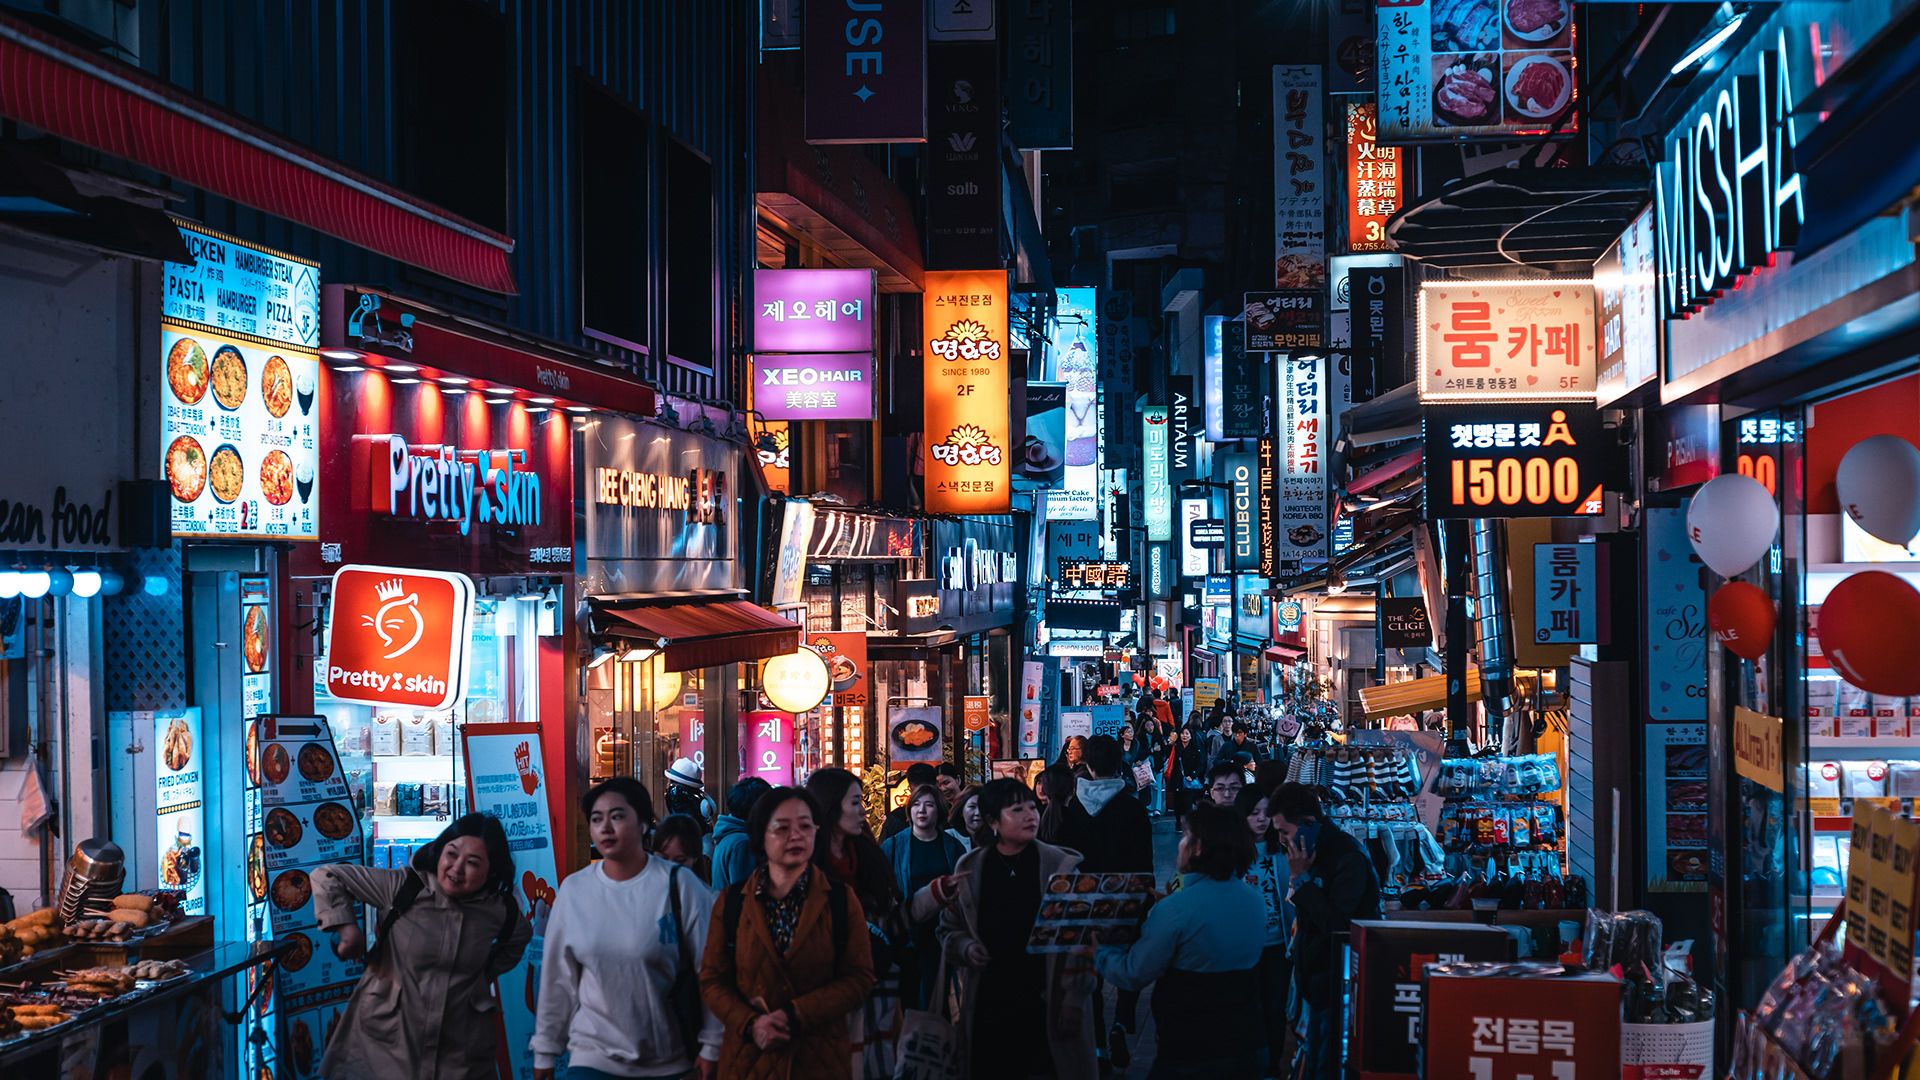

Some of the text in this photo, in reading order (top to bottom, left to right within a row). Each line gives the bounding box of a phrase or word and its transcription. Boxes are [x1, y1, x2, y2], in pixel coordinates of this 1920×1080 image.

[1393, 11, 1414, 127] 한우삼겹
[1656, 27, 1805, 320] MISSHA
[947, 182, 979, 196] solb
[235, 250, 294, 285] HAMBURGER STEAK
[169, 276, 205, 304] PASTA
[217, 288, 257, 316] HAMBURGER
[935, 294, 993, 307] 스낵전문점
[267, 301, 293, 325] PIZZA
[762, 299, 862, 322] 제오헤어
[1266, 297, 1312, 312] 엉터리
[1274, 334, 1321, 348] 무한리필
[1443, 302, 1580, 368] 룸 카페
[930, 337, 1000, 361] 명화당
[942, 368, 991, 377] SINCE 1980
[1446, 377, 1518, 390] 스위트룸 명동점
[1559, 376, 1580, 389] 5F
[786, 391, 838, 409] 美容室
[957, 385, 975, 396] 2F
[1174, 392, 1188, 468] ARITAUM
[1451, 423, 1516, 448] 첫방문
[931, 442, 1002, 466] 명화당
[1149, 429, 1166, 514] 미도리가방
[1452, 457, 1579, 506] 15000
[389, 435, 541, 536] Pretty skin
[596, 467, 618, 504] BEE
[619, 470, 657, 509] CHENG
[658, 474, 691, 510] HIANG
[937, 480, 994, 493] 스낵전문점
[51, 486, 111, 549] food
[1236, 465, 1250, 558] CLUBCLIO
[1586, 501, 1602, 513] 2F
[1151, 547, 1161, 595] TONYMOLY
[1549, 548, 1582, 639] 룸카페
[1388, 622, 1425, 631] CLIGE
[329, 665, 447, 696] Pretty skin
[516, 756, 529, 770] HIT
[158, 770, 200, 789] FRIED CHICKEN
[1472, 1016, 1576, 1056] 전품목
